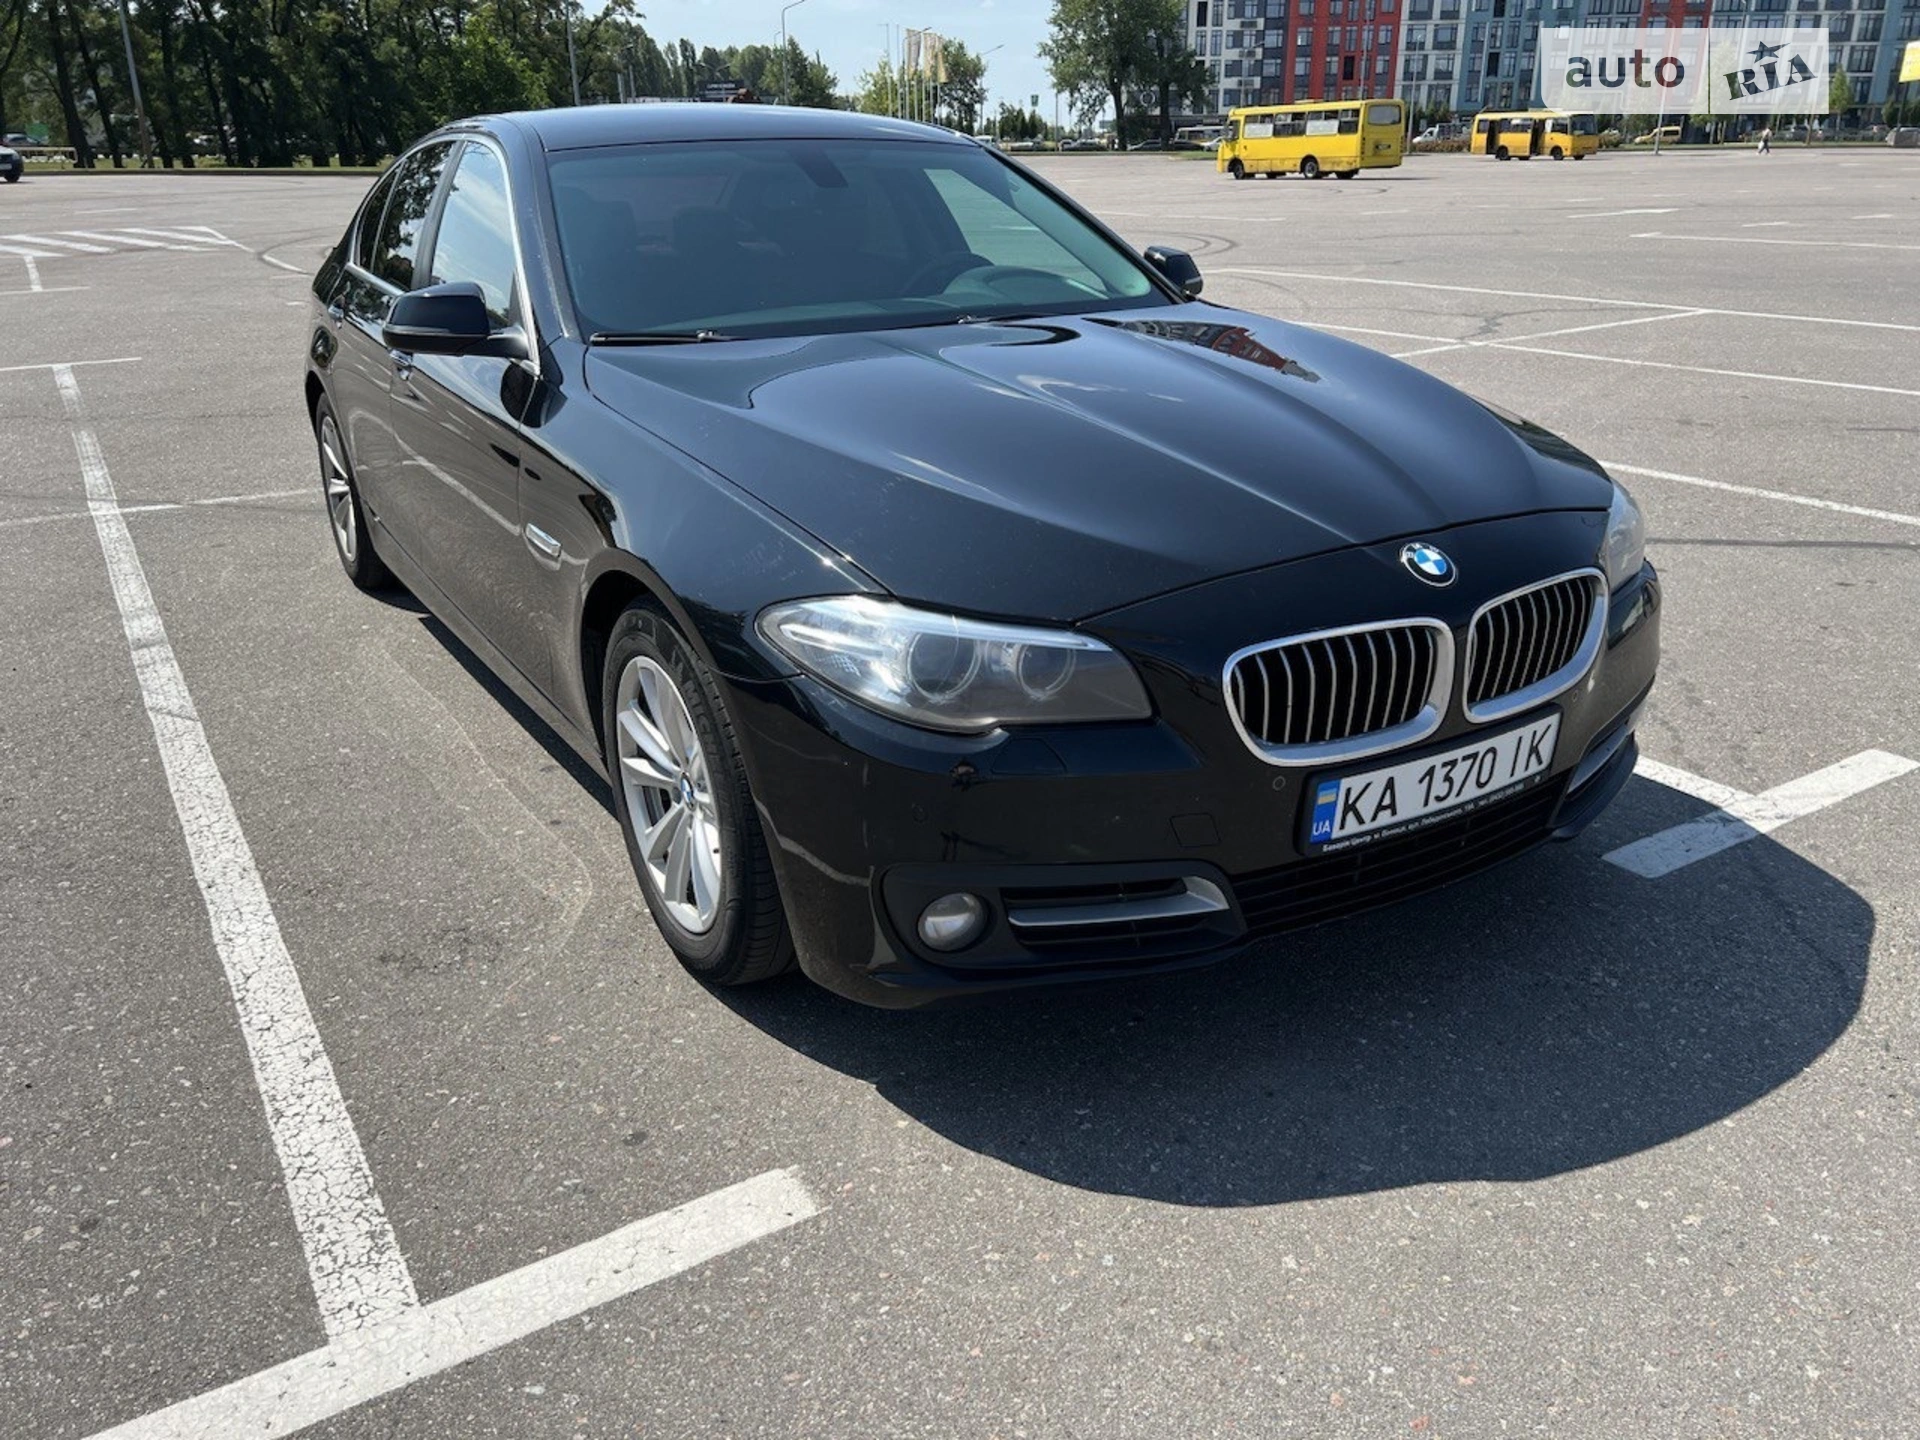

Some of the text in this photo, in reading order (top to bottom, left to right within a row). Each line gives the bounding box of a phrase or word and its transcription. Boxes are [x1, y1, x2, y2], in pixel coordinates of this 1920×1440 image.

[1338, 776, 1398, 831] KA
[1418, 746, 1497, 808] 1370
[1509, 724, 1552, 778] IK
[1313, 820, 1331, 836] UA
